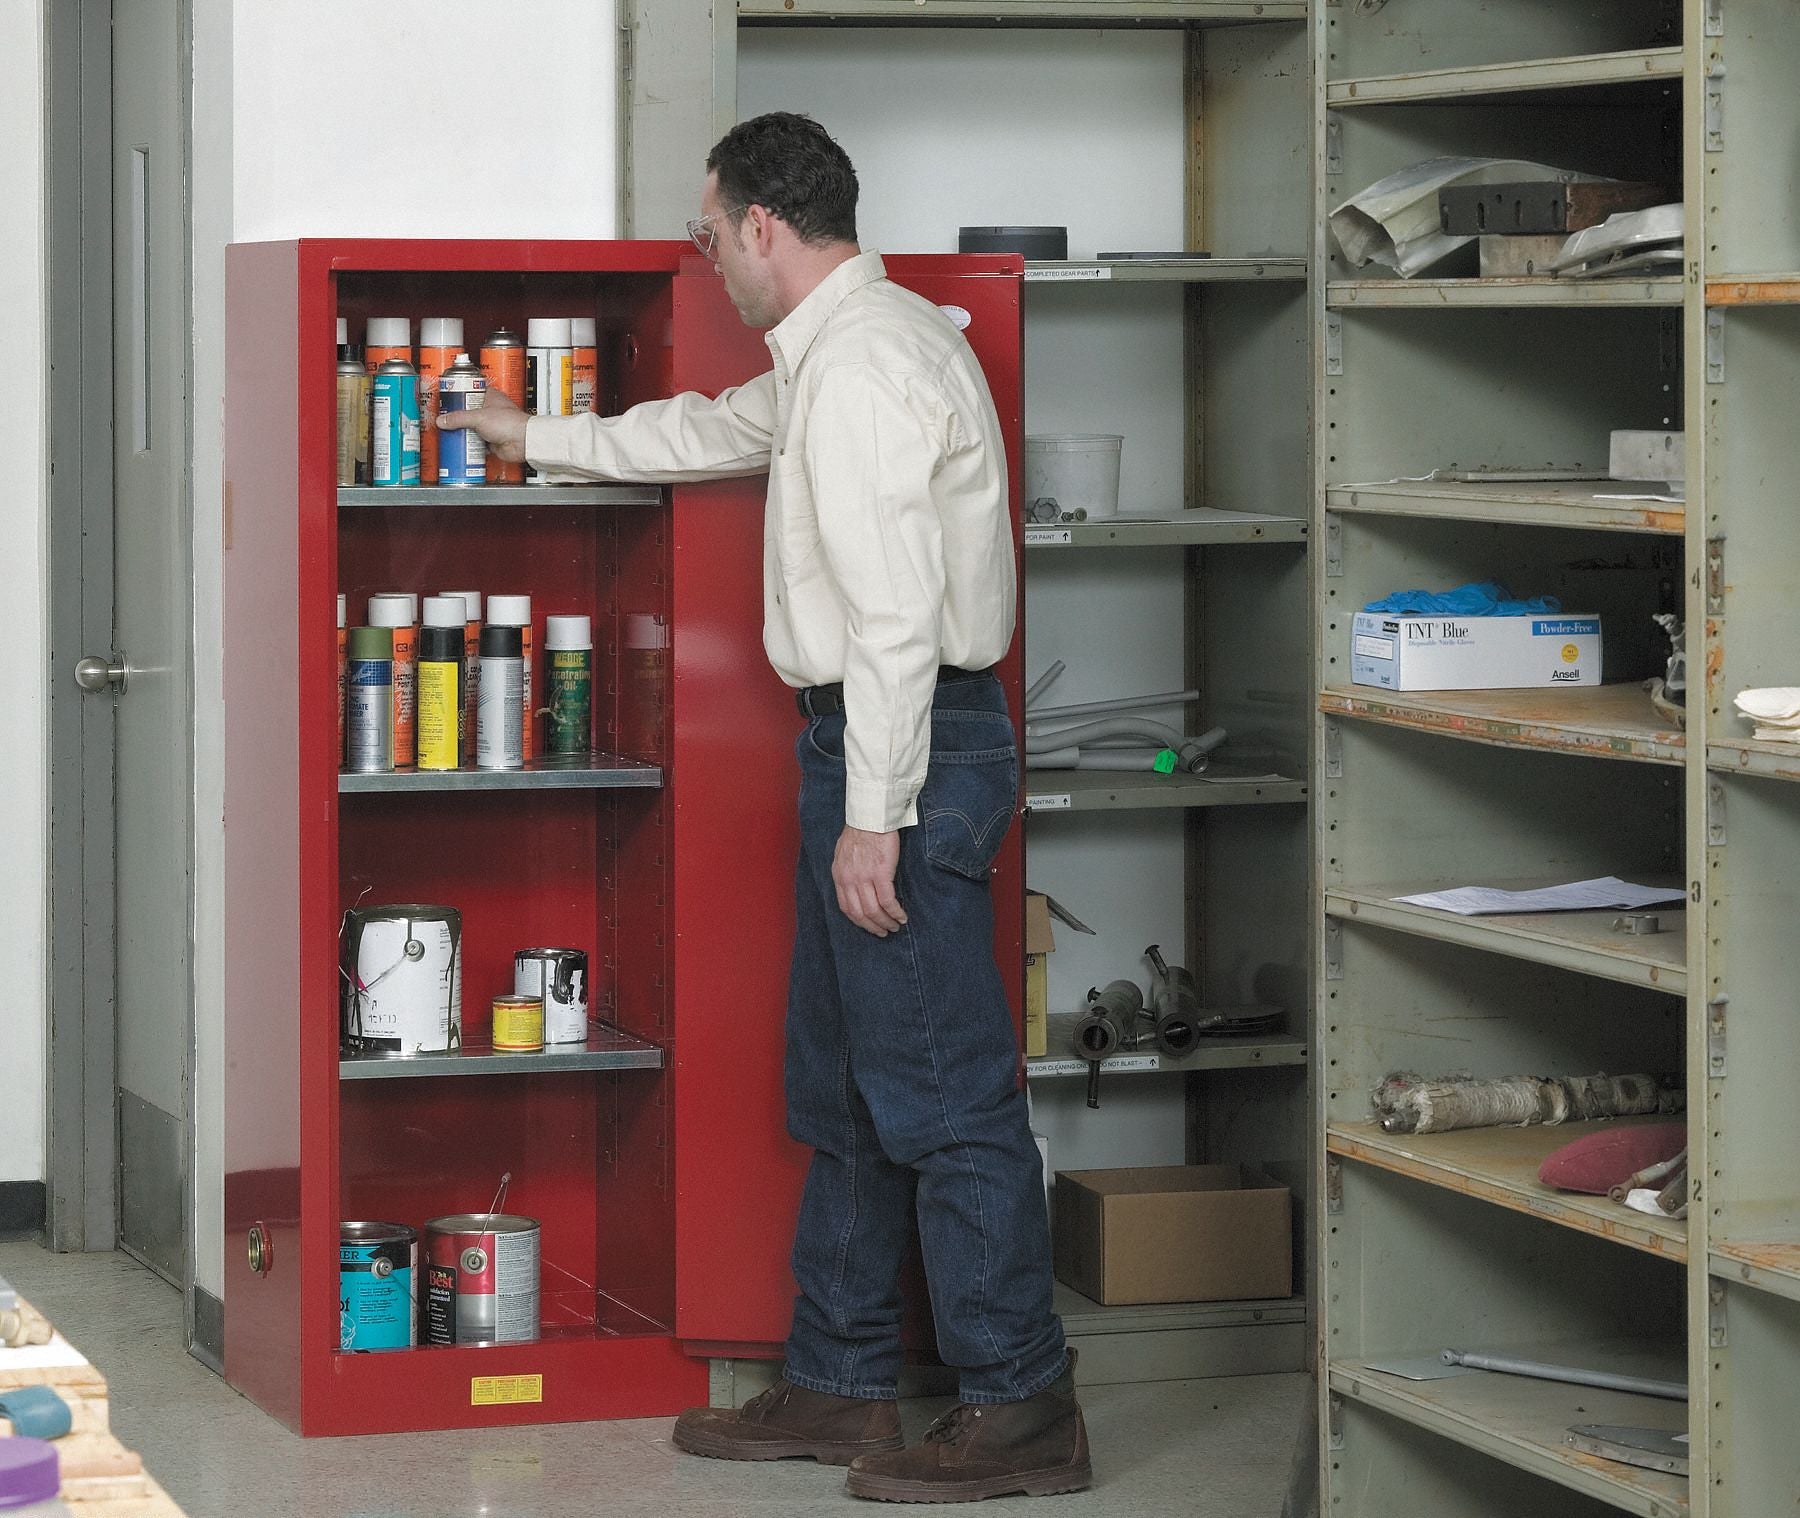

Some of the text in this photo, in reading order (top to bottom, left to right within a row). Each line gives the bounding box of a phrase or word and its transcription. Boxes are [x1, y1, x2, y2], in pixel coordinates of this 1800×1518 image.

[1443, 621, 1468, 638] Blue
[1540, 622, 1593, 633] Powder-Free
[1552, 669, 1580, 679] Ansell
